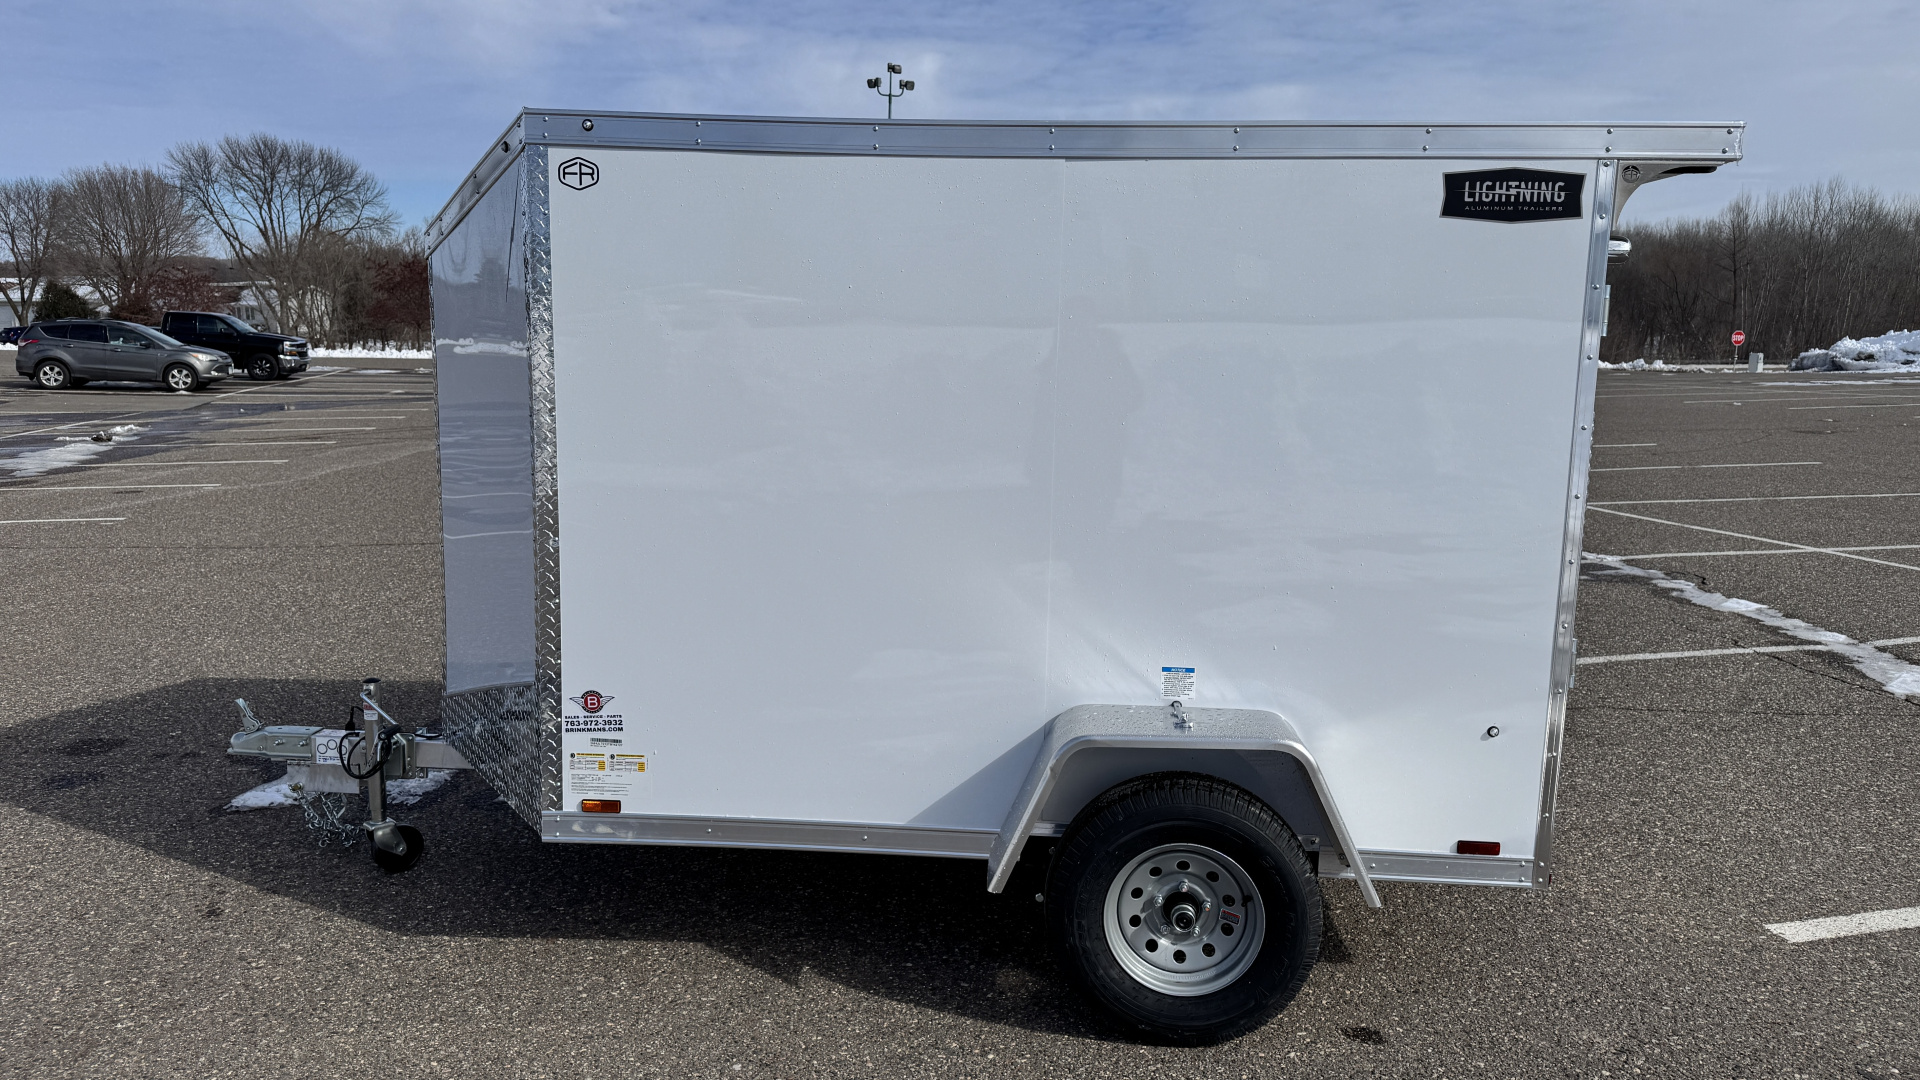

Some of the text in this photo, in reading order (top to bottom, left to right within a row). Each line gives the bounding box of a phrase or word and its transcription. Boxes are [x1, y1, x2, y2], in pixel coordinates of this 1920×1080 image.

[1464, 180, 1566, 203] LIGHTNING
[587, 696, 598, 708] B
[564, 719, 623, 727] 763-972-3932
